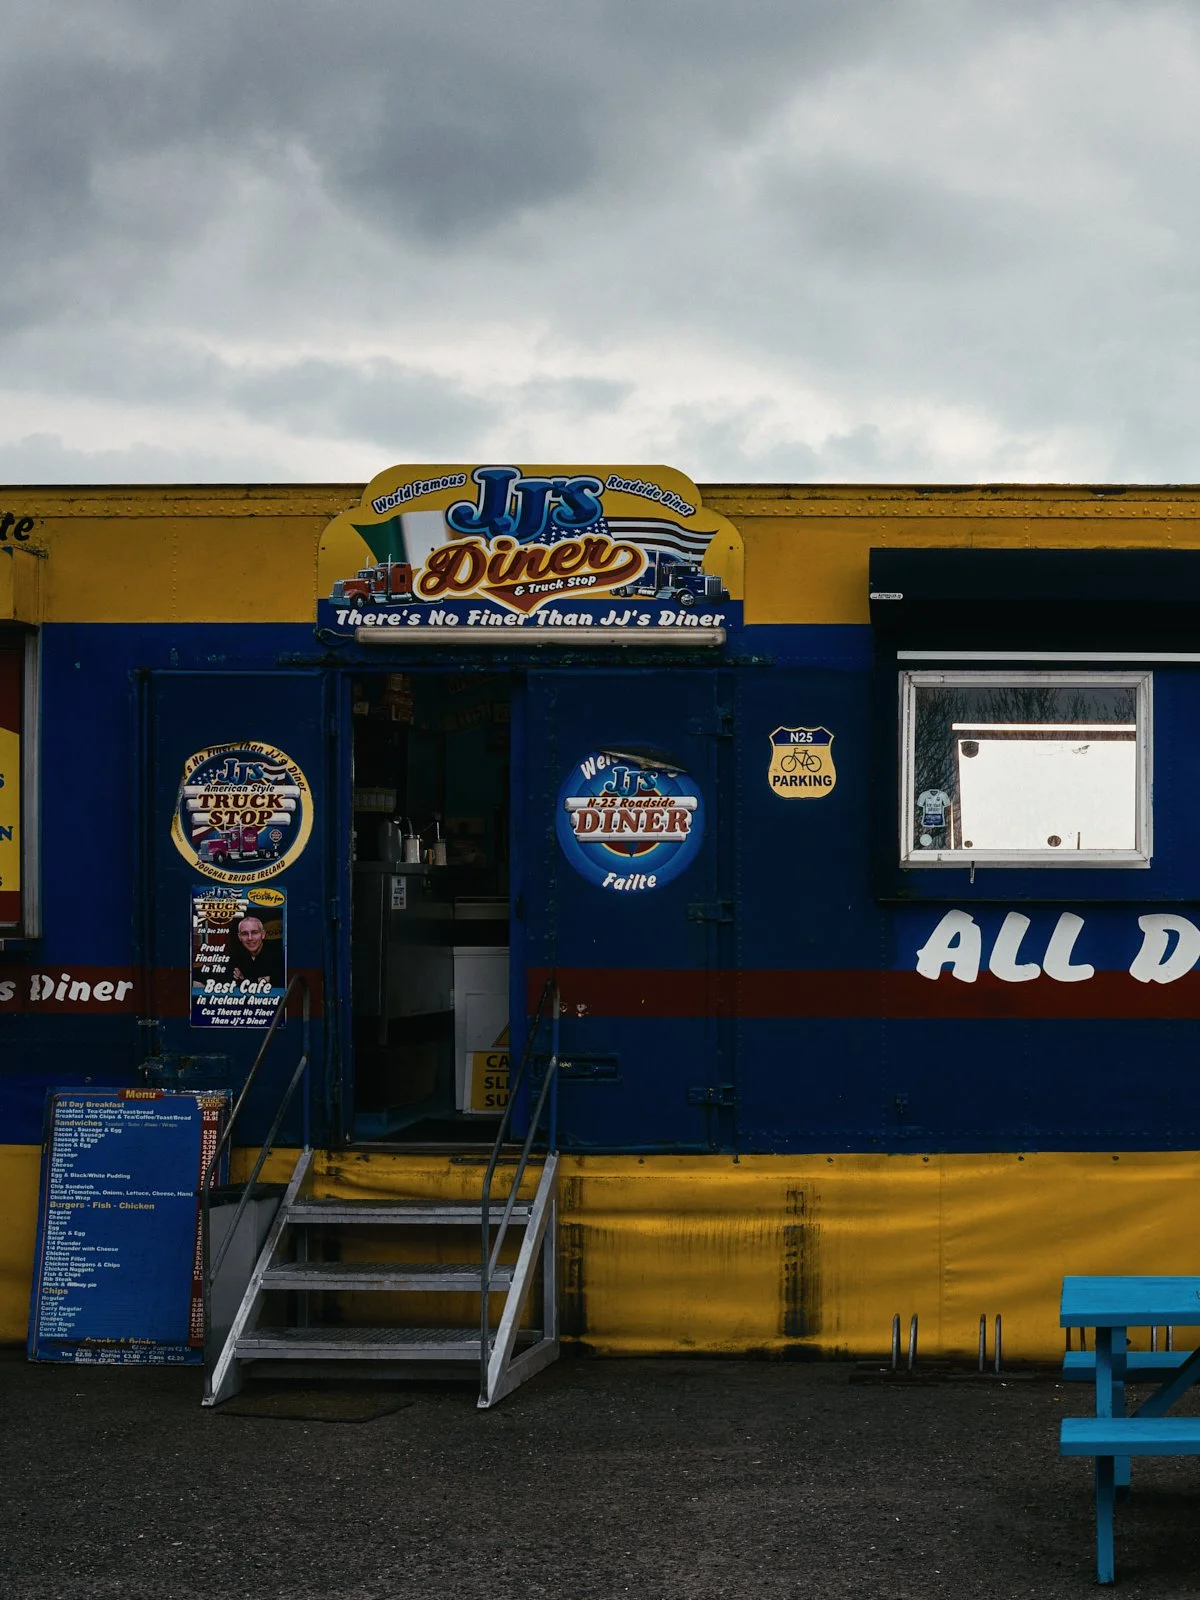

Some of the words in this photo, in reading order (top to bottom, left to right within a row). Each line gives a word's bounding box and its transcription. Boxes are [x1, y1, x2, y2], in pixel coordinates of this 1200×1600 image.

[373, 484, 413, 513] World
[414, 473, 467, 498] Famous
[606, 474, 661, 501] Roadside
[659, 491, 696, 517] Diner
[445, 466, 604, 544] JJ's
[415, 535, 648, 599] Diner
[514, 584, 525, 596] &
[528, 578, 564, 595] Truck
[566, 573, 597, 590] Stop
[335, 610, 421, 626] There's
[428, 610, 458, 626] No
[468, 610, 529, 626] Finer
[535, 610, 593, 627] Than
[599, 610, 651, 627] JJ's
[659, 611, 726, 627] Diner
[790, 732, 813, 743] N25
[192, 755, 204, 767] No
[239, 741, 264, 754] Than
[287, 766, 307, 792] Diner
[218, 758, 265, 784] JJ's
[204, 784, 248, 793] American
[250, 783, 275, 795] Style
[604, 766, 658, 797] JJ's
[773, 775, 832, 786] PARKING
[198, 793, 284, 810] TRUCK
[587, 798, 616, 808] N-25
[620, 797, 676, 808] Roadside
[208, 810, 274, 827] STOP
[574, 808, 691, 834] DINER
[194, 859, 227, 881] YOUGHAL
[227, 873, 256, 882] BRIDGE
[257, 860, 286, 879] IRELAND
[602, 872, 657, 891] Failte
[200, 943, 226, 952] Proud
[916, 909, 1095, 983] ALL
[195, 953, 231, 963] Finalists
[201, 964, 210, 973] In
[212, 964, 226, 973] The
[30, 972, 134, 1002] Diner
[204, 978, 237, 994] Best
[239, 978, 272, 995] Cafe
[196, 995, 207, 1005] in
[208, 995, 247, 1006] Ireland
[247, 995, 281, 1006] Award
[201, 1008, 215, 1016] Coz
[216, 1008, 242, 1016] Theres
[242, 1008, 253, 1016] No
[254, 1008, 275, 1016] Finer
[211, 1017, 228, 1025] Than
[246, 1017, 268, 1025] Diner
[125, 1089, 156, 1099] Menu
[69, 1101, 84, 1109] Day
[42, 1287, 69, 1295] Chips
